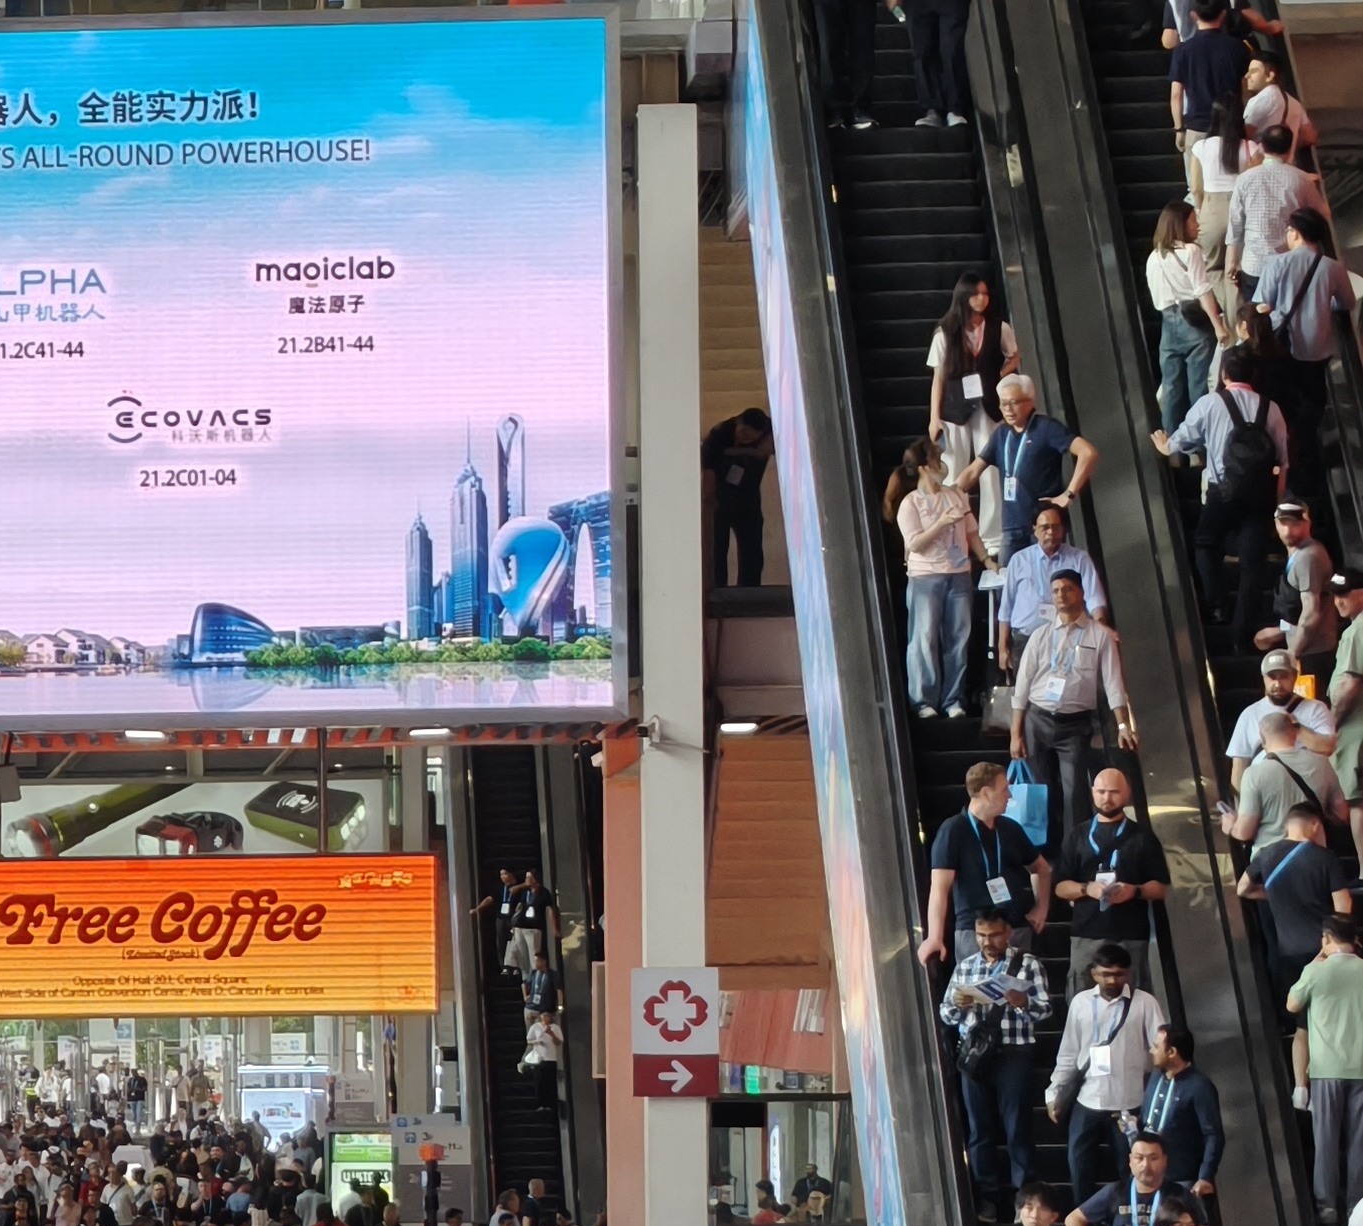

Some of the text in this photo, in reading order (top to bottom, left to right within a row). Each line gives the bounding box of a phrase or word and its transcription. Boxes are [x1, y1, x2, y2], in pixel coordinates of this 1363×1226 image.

[22, 144, 174, 169] ALL-ROUND
[181, 140, 371, 166] POWERHOUSE!
[288, 294, 365, 314] 魔法原子
[277, 336, 375, 355] 21.2B41-44
[140, 469, 237, 487] 21.2C01-04
[150, 888, 327, 960] Coffee
[177, 975, 210, 984] Central
[25, 988, 45, 998] Side
[60, 988, 94, 997] Canton
[97, 987, 150, 997] Convention
[191, 986, 212, 996] Area
[228, 986, 262, 996] Canton
